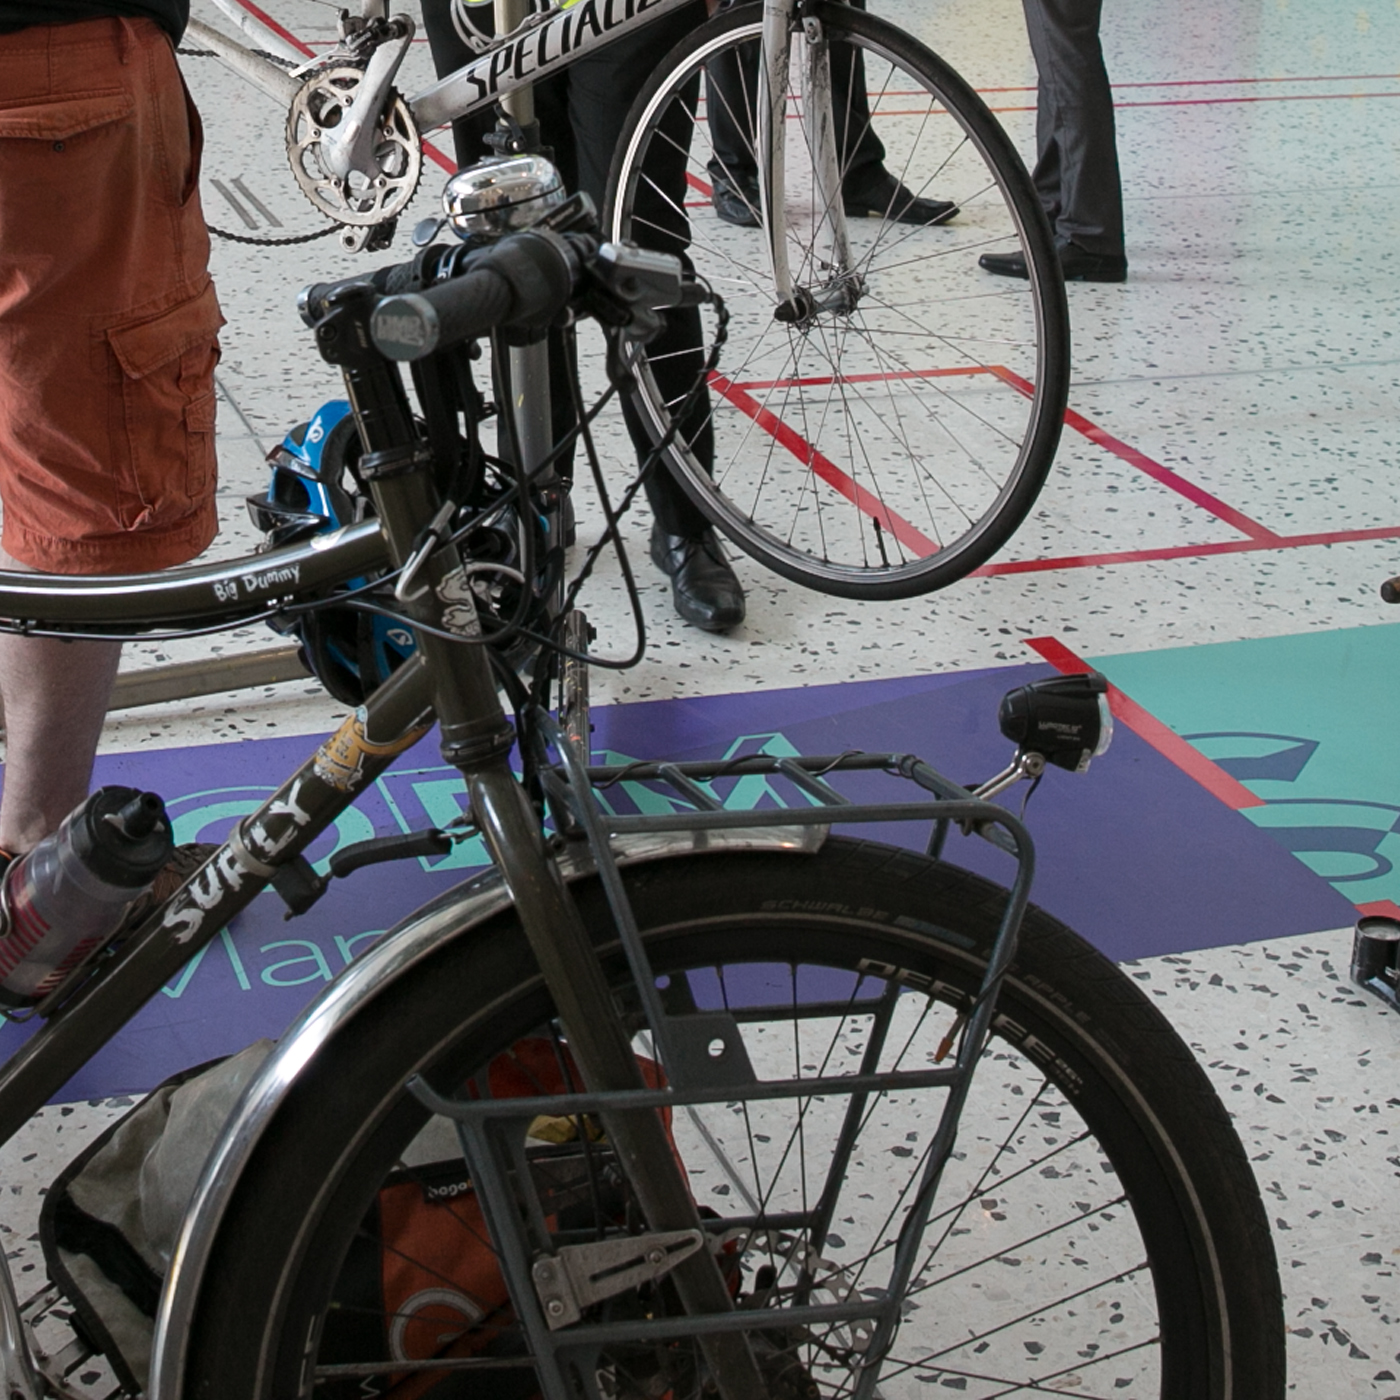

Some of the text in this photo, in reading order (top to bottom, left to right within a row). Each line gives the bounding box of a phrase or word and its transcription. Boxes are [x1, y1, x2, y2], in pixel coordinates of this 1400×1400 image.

[213, 565, 300, 602] Big Dummy
[162, 778, 312, 945] SURLY
